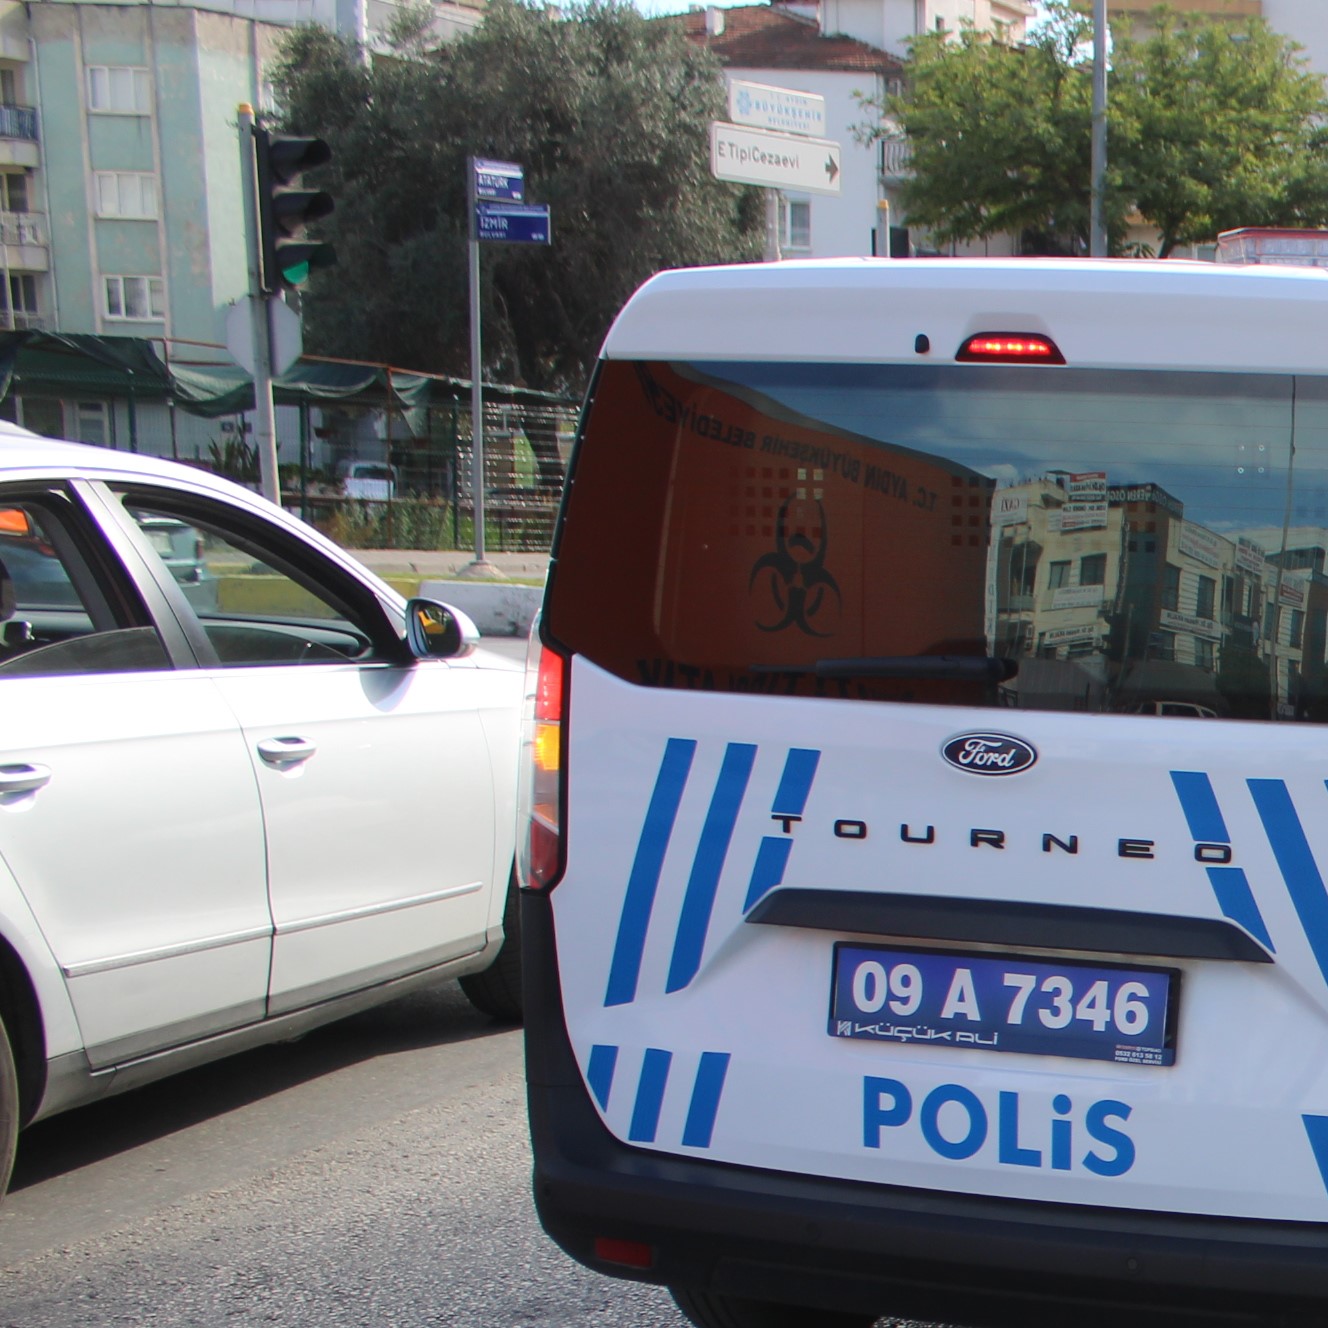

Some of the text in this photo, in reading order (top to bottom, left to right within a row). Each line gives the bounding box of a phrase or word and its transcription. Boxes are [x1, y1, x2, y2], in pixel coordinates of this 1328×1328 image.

[959, 739, 1016, 767] Ford
[771, 813, 1234, 865] TOURNEO
[853, 960, 1150, 1035] 09 A 7346
